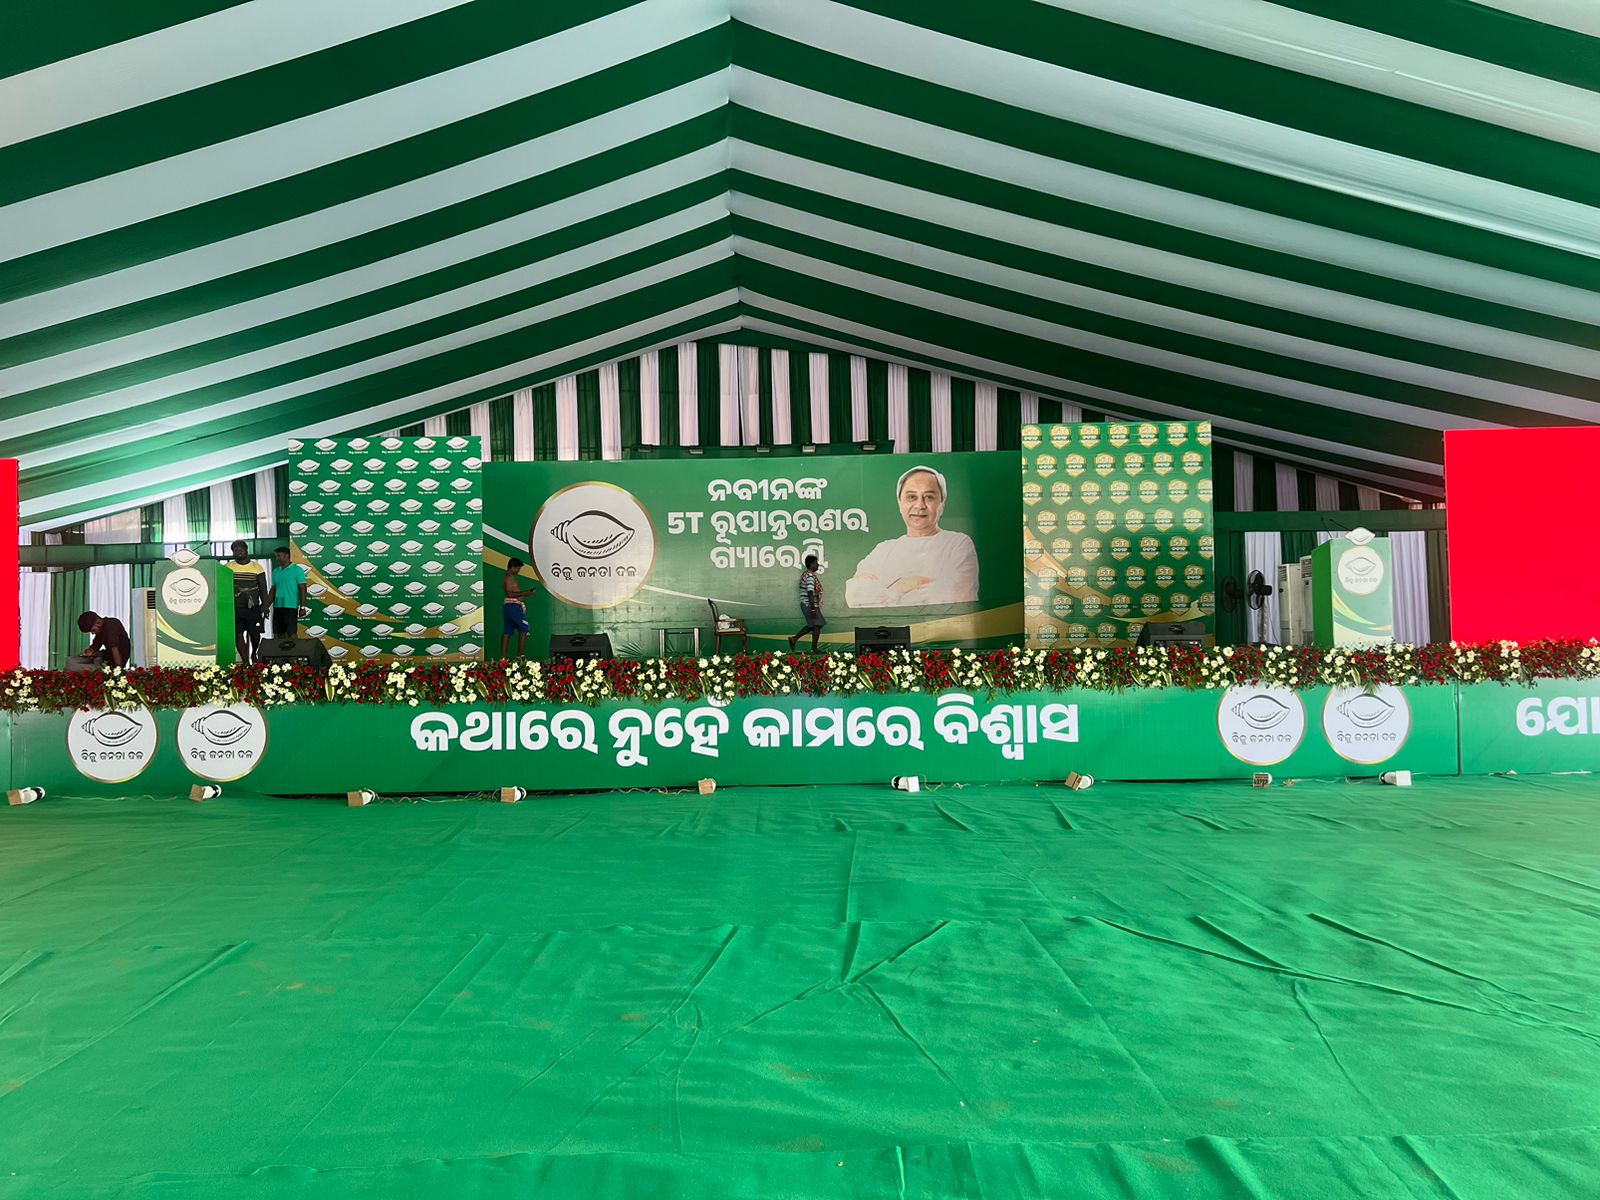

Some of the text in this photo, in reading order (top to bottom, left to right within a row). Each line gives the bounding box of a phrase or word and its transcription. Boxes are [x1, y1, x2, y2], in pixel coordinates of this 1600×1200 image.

[707, 478, 828, 501] ନବୀନଙ୍କ
[667, 508, 869, 544] 5T ରୂପାନ୍ତରଣର
[551, 562, 637, 581] ବିଜୁ ଜନତା ଦଳ
[410, 710, 599, 754] କଥାରେ
[742, 706, 924, 751] କାମରେ
